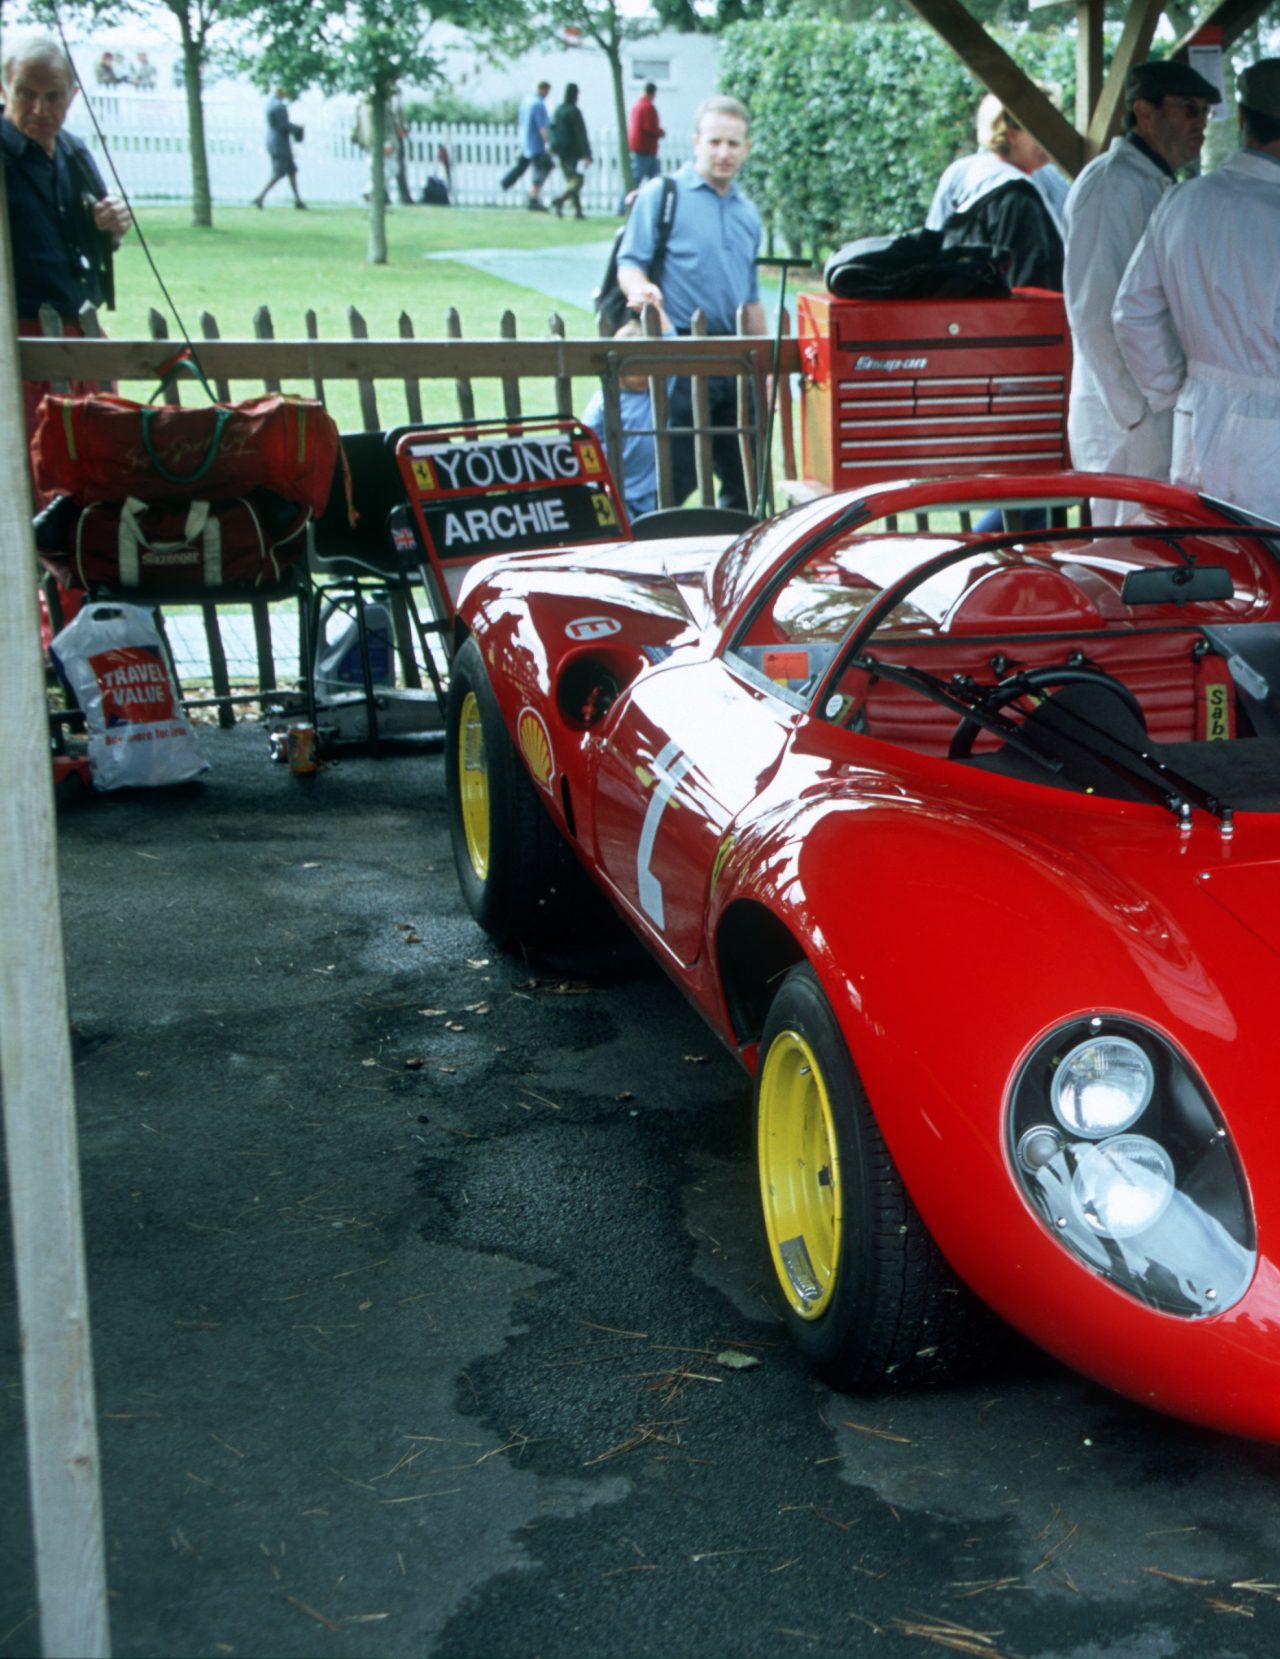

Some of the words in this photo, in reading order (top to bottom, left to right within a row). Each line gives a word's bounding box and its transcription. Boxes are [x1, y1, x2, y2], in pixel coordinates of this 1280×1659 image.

[434, 444, 580, 490] YOUNG
[445, 499, 570, 546] ARCHIE
[103, 663, 166, 688] TRAVEL
[112, 684, 165, 706] VALUE
[1210, 688, 1226, 741] Sab
